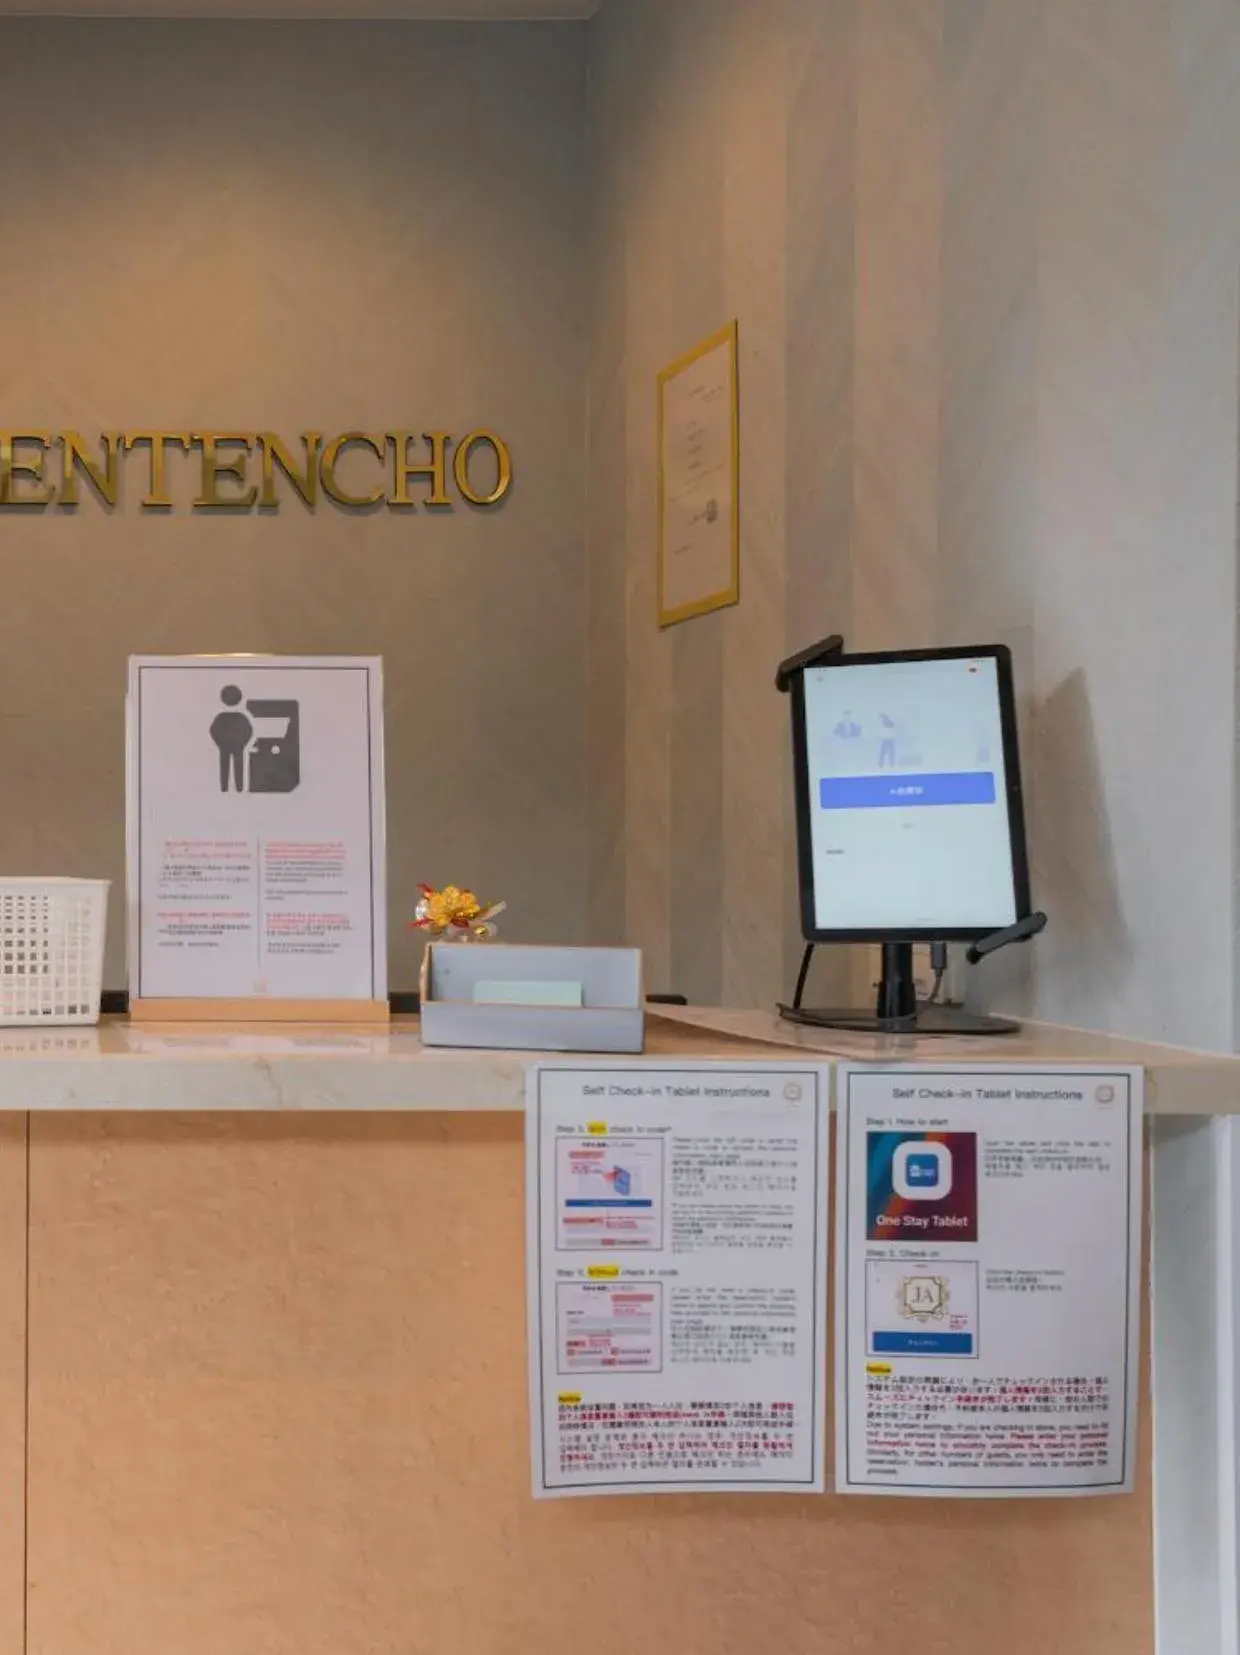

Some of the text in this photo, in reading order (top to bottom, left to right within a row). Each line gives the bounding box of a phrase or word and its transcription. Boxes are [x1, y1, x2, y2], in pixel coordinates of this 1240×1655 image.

[582, 1085, 771, 1099] Self Check-in Tablet Instructions
[892, 1087, 1083, 1101] Self Check-in Tablet Instructions
[876, 1215, 968, 1229] One Stay Tablet
[911, 1286, 935, 1305] JA
